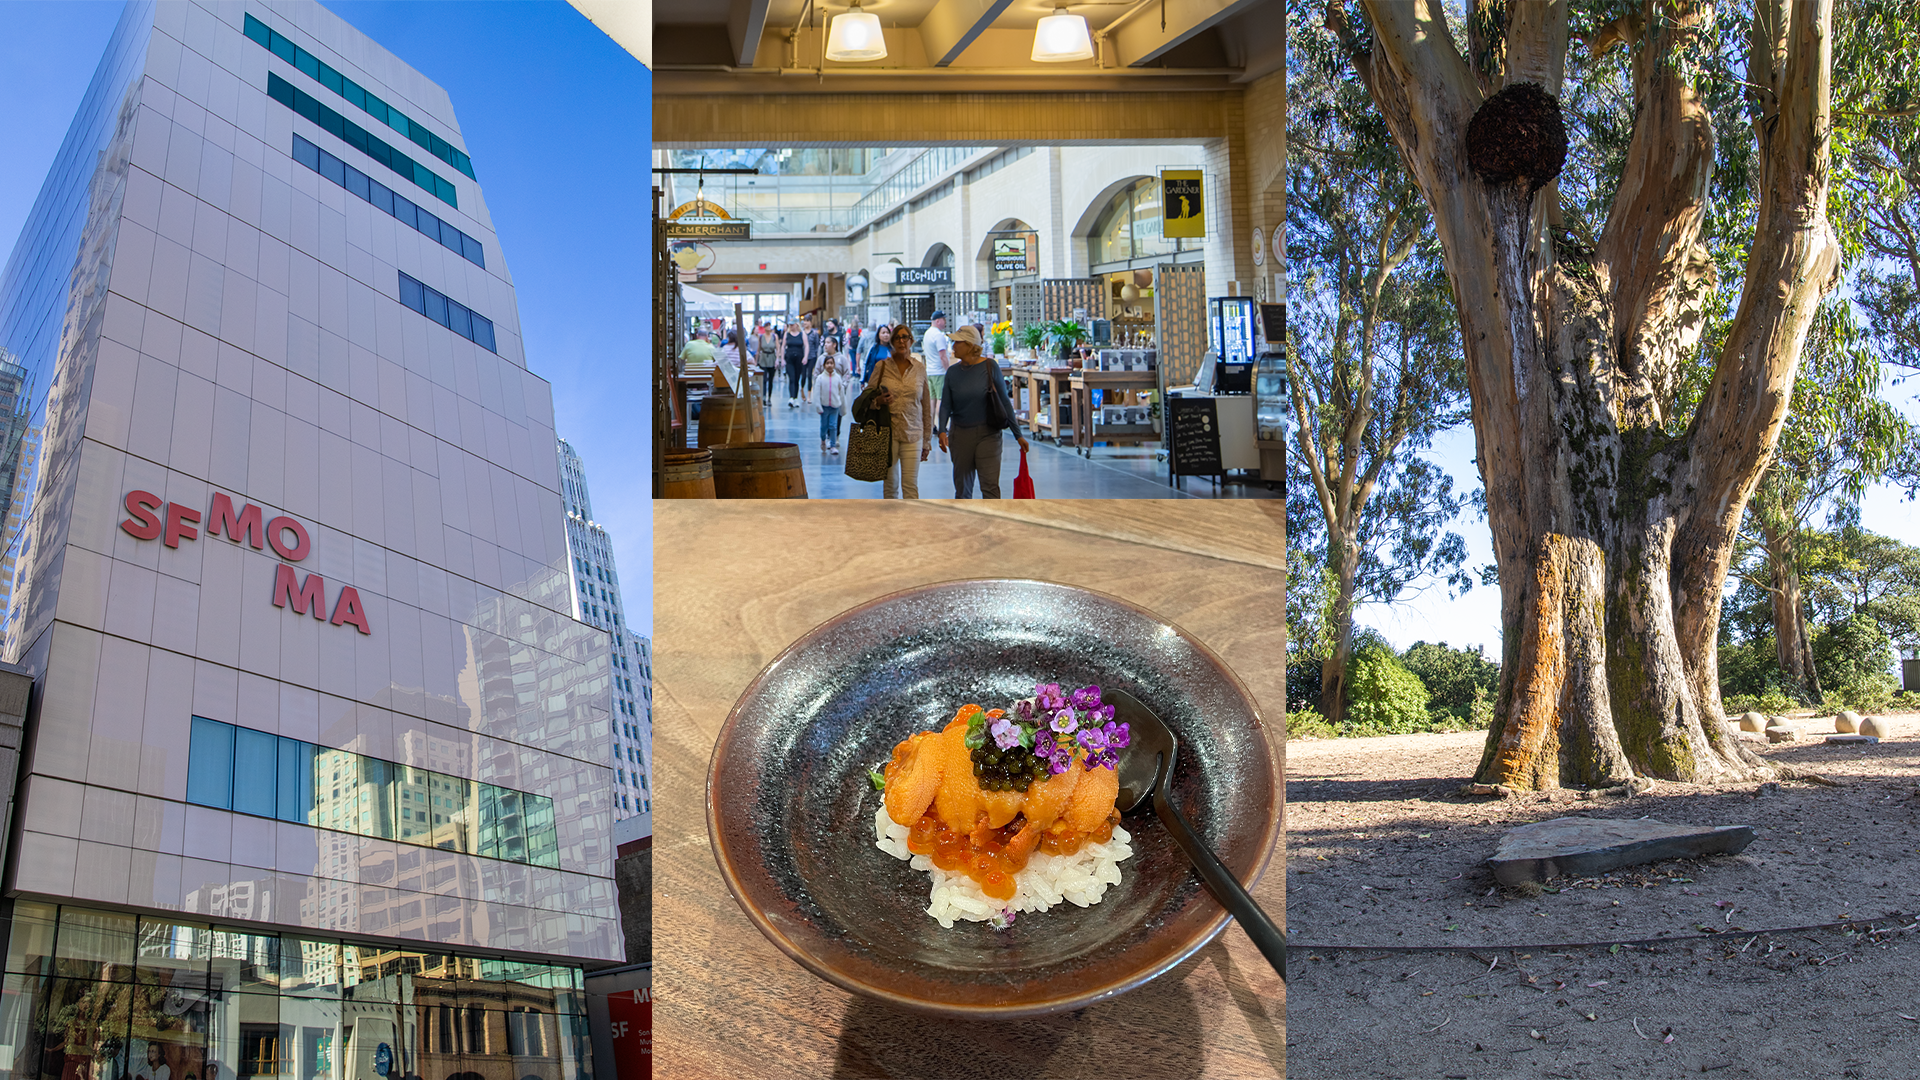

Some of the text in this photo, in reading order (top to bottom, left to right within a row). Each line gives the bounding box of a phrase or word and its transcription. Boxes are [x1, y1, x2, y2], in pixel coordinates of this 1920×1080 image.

[1165, 186, 1199, 194] GARDENER
[686, 226, 746, 235] MERCHANT
[273, 562, 372, 635] MA
[633, 987, 652, 1004] M
[611, 1021, 629, 1039] SF
